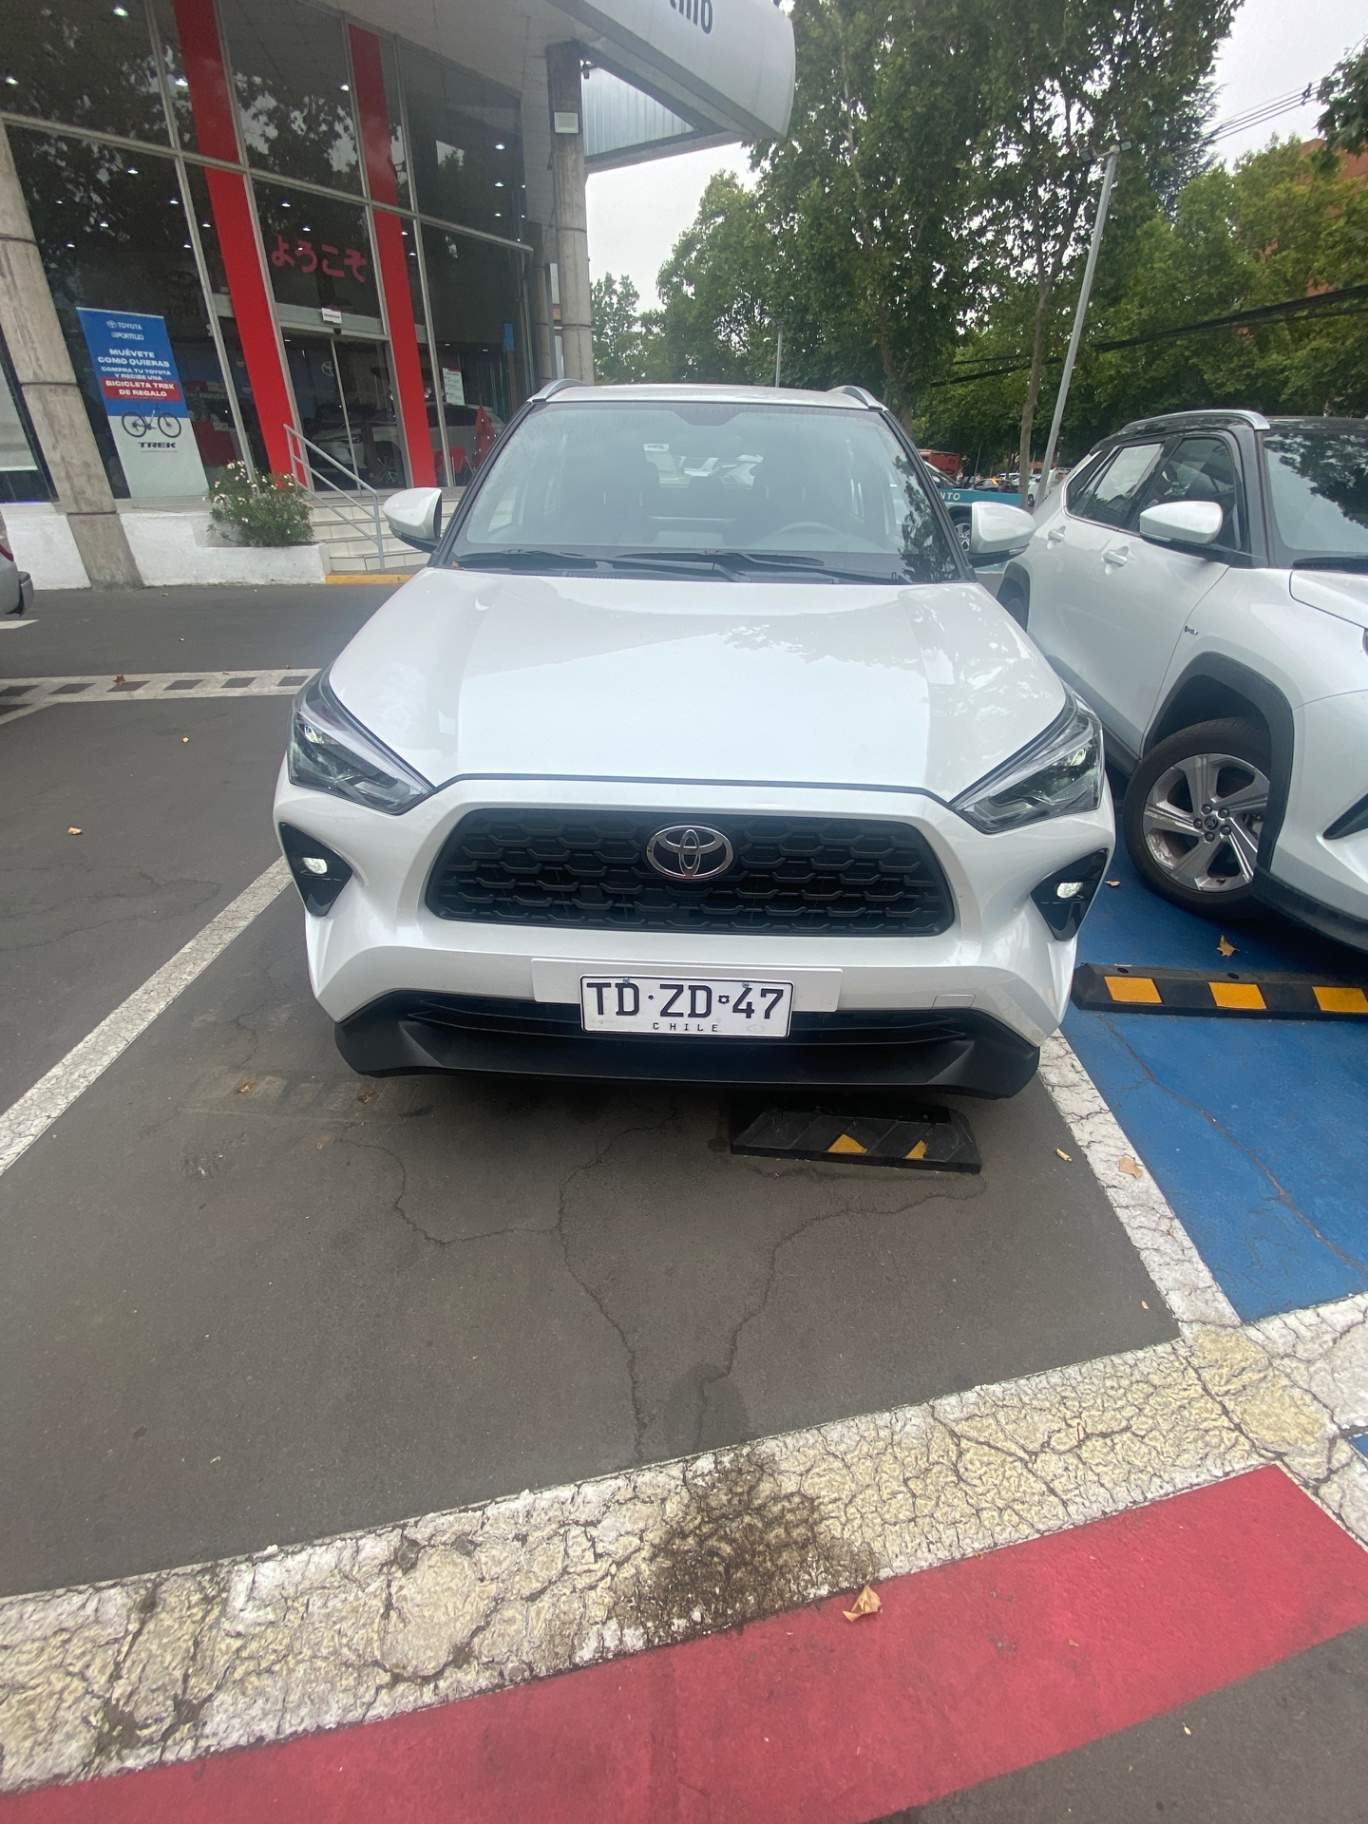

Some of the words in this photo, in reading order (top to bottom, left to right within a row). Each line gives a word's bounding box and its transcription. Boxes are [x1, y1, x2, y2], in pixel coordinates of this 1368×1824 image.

[270, 233, 367, 283] ようこそ
[109, 348, 155, 358] MUÉVETE
[97, 356, 128, 364] COMO
[129, 359, 170, 368] QUIERAS
[105, 380, 151, 388] BICICLETA
[152, 382, 175, 390] TREK
[132, 389, 168, 397] REGALO
[138, 441, 176, 449] TREK
[652, 1022, 720, 1033] CHILE
